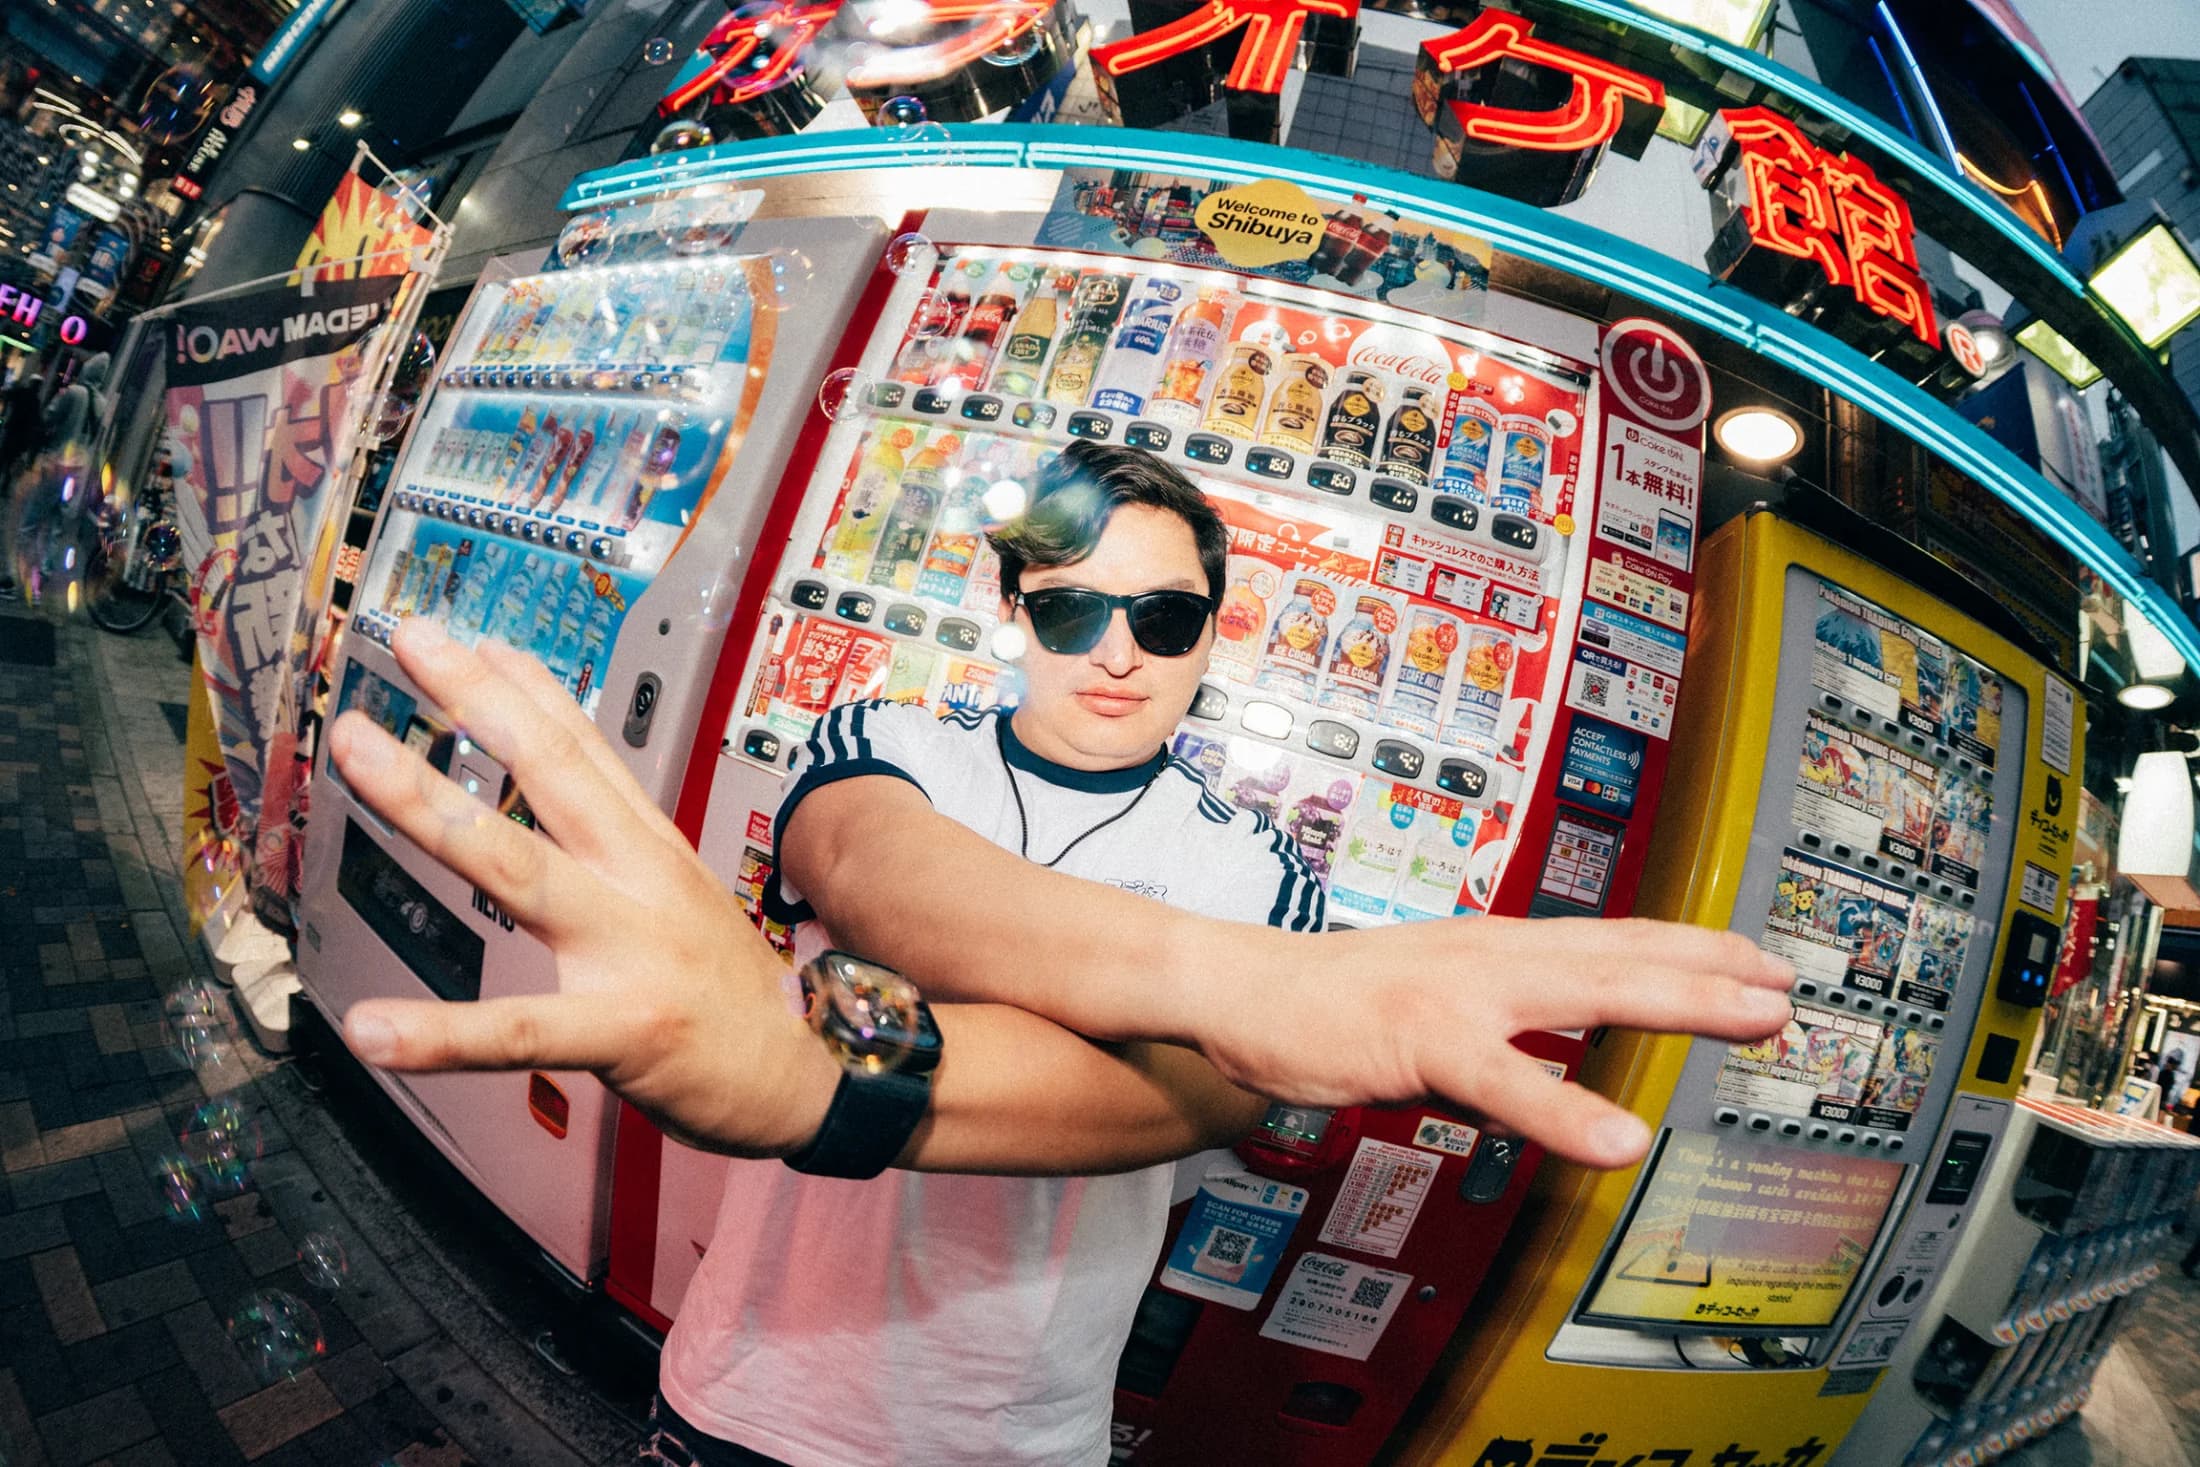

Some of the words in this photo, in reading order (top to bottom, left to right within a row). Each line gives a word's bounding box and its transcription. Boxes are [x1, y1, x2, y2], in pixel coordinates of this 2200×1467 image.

[1217, 196, 1297, 223] Welcome
[1299, 214, 1319, 226] to
[1207, 210, 1314, 247] Shibuya
[1352, 345, 1443, 386] Coca-Cola
[1639, 435, 1666, 456] Coke
[1611, 443, 1693, 510] 1本無料!
[1411, 532, 1542, 582] キャッシュレスでのご購入方法
[1596, 585, 1610, 596] VISA
[1862, 606, 1900, 634] TRADING
[1572, 736, 1628, 761] CONTACTLESS
[1574, 727, 1606, 743] ACCEPT
[1570, 746, 1611, 765] PAYMENTS
[1851, 733, 1889, 759] TRADING
[1889, 749, 1912, 770] CARD
[1795, 1006, 1835, 1029] TRADING
[1453, 1127, 1469, 1139] OK
[1206, 1200, 1232, 1214] SCAN
[1230, 1207, 1250, 1218] FOR
[1250, 1214, 1283, 1229] OFFERS
